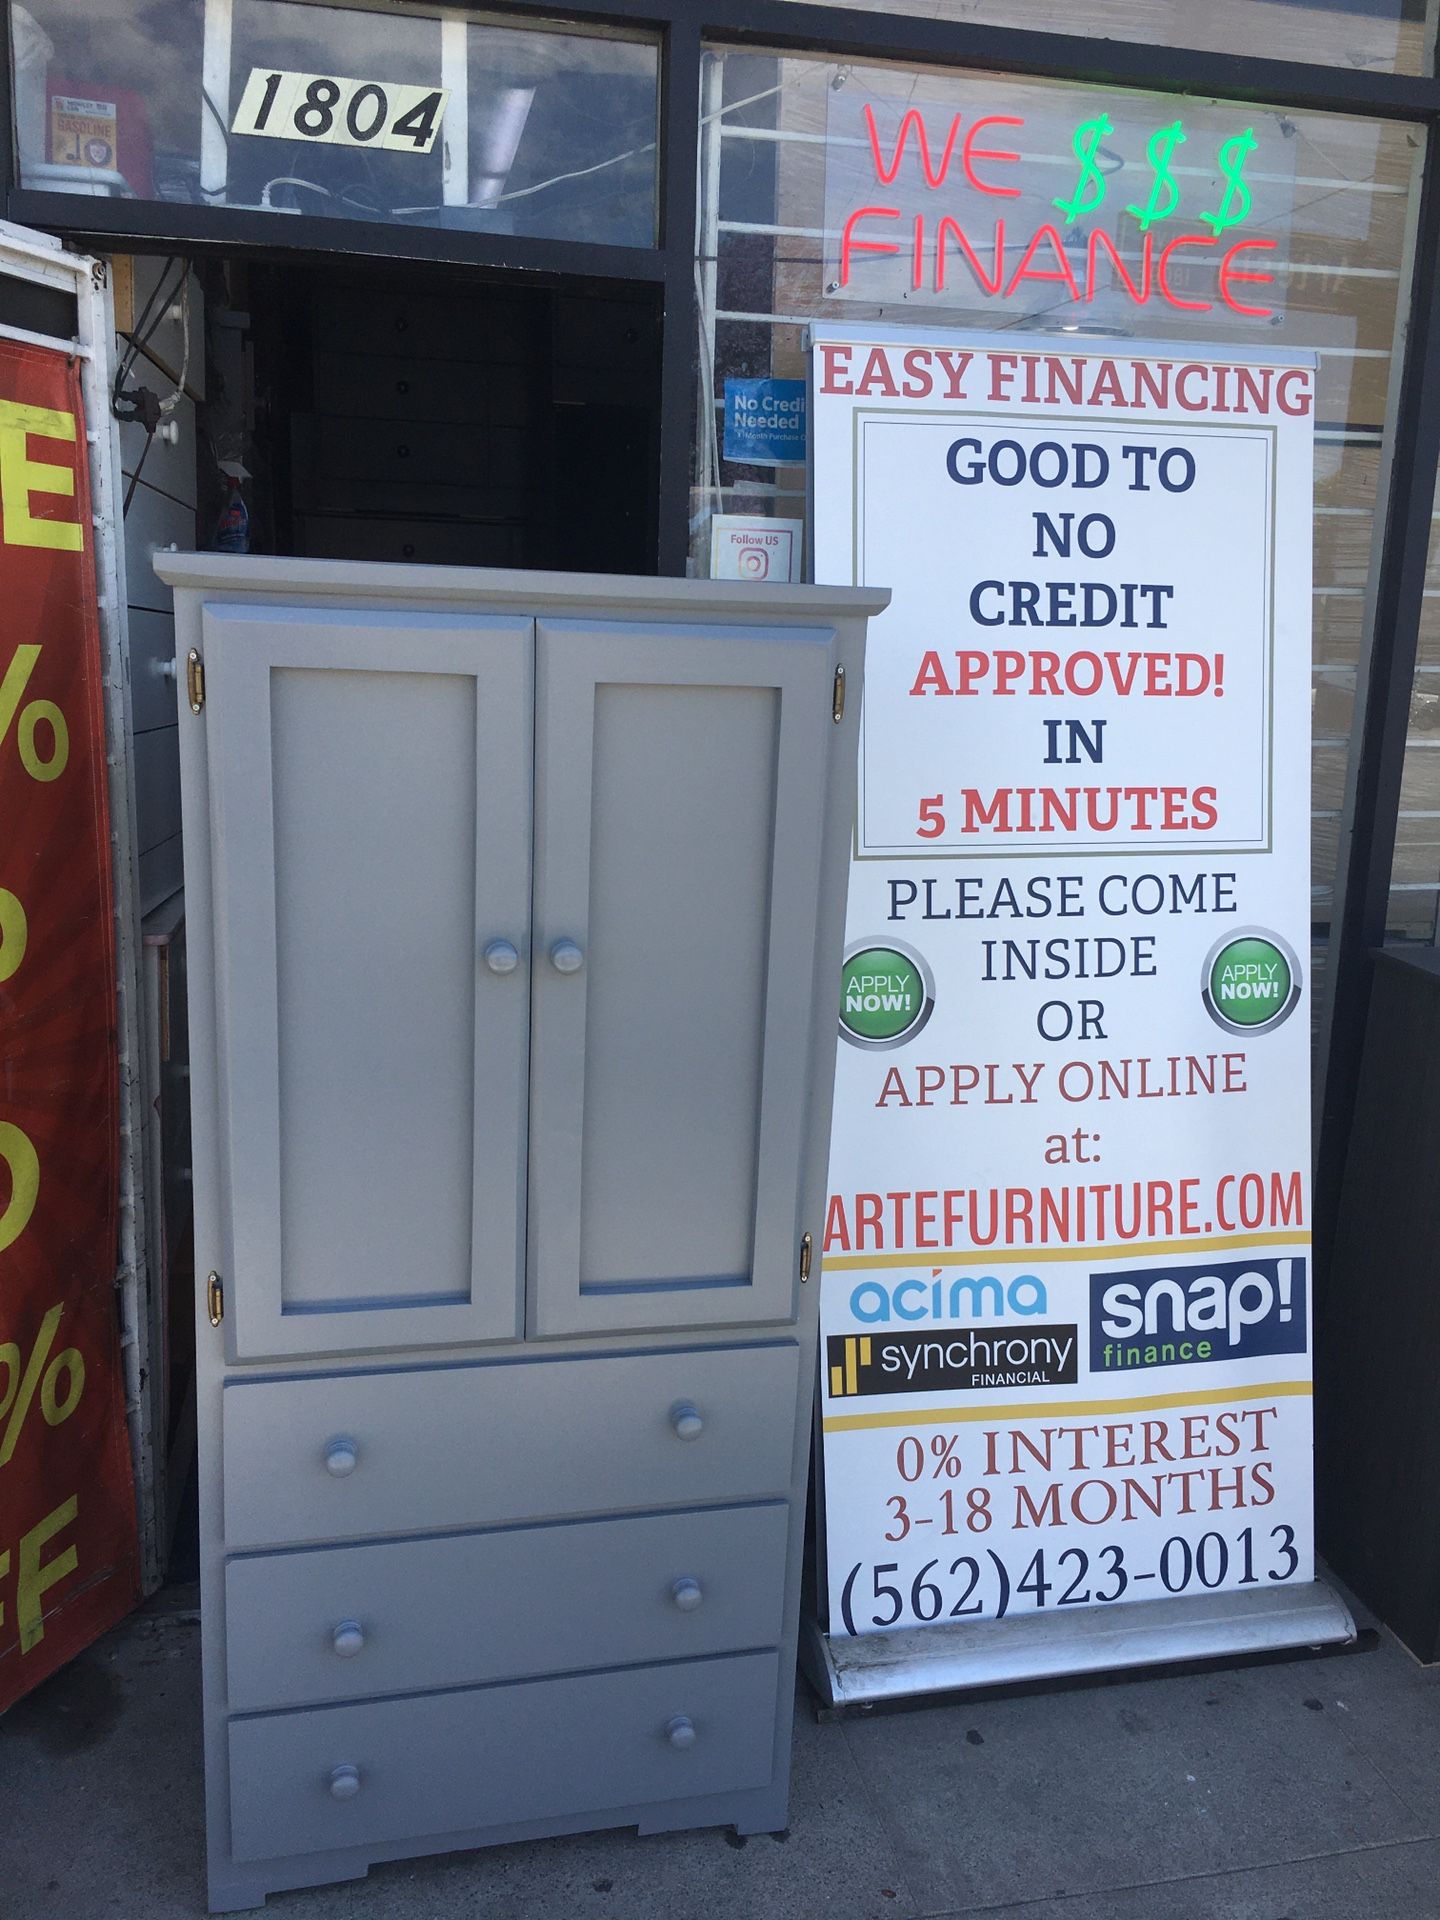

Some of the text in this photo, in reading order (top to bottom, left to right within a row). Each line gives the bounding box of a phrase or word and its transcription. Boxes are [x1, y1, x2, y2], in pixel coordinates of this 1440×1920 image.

[254, 74, 443, 147] 1804
[865, 103, 1024, 197] WE
[840, 207, 1278, 317] FINANCE
[734, 395, 806, 413] No Credi
[819, 345, 1313, 416] EASY FINANCING
[734, 412, 799, 429] Needed
[769, 432, 799, 441] Purchase
[946, 438, 1196, 493] GOOD TO
[731, 534, 779, 546] Follow US
[1032, 512, 1116, 559] NO
[968, 580, 1174, 629] CREDIT
[909, 650, 1225, 698] APPROVED!
[1043, 720, 1107, 764] IN
[916, 786, 1218, 839] 5 MINUTES
[887, 872, 1238, 920] PLEASE COME
[981, 936, 1157, 981] INSIDE
[1221, 963, 1278, 982] APPLY
[845, 994, 911, 1012] NOW!
[846, 975, 910, 993] APPLY
[1221, 981, 1279, 1000] NOW!
[1037, 1000, 1108, 1042] OR
[875, 1053, 1248, 1108] APPLY ONLINE
[1044, 1127, 1102, 1165] at:
[822, 1171, 1304, 1252] ARTEFURNITURE.COM
[850, 1268, 1048, 1324] acima
[1101, 1258, 1293, 1346] snap!
[881, 1332, 1073, 1380] synchrony
[1103, 1340, 1212, 1367] finance
[971, 1370, 1051, 1387] FINANCIAL
[896, 1407, 1278, 1483] 0% INTEREST
[885, 1462, 1277, 1542] 3-18 MONTHS
[840, 1524, 1300, 1637] (562)423-0013
